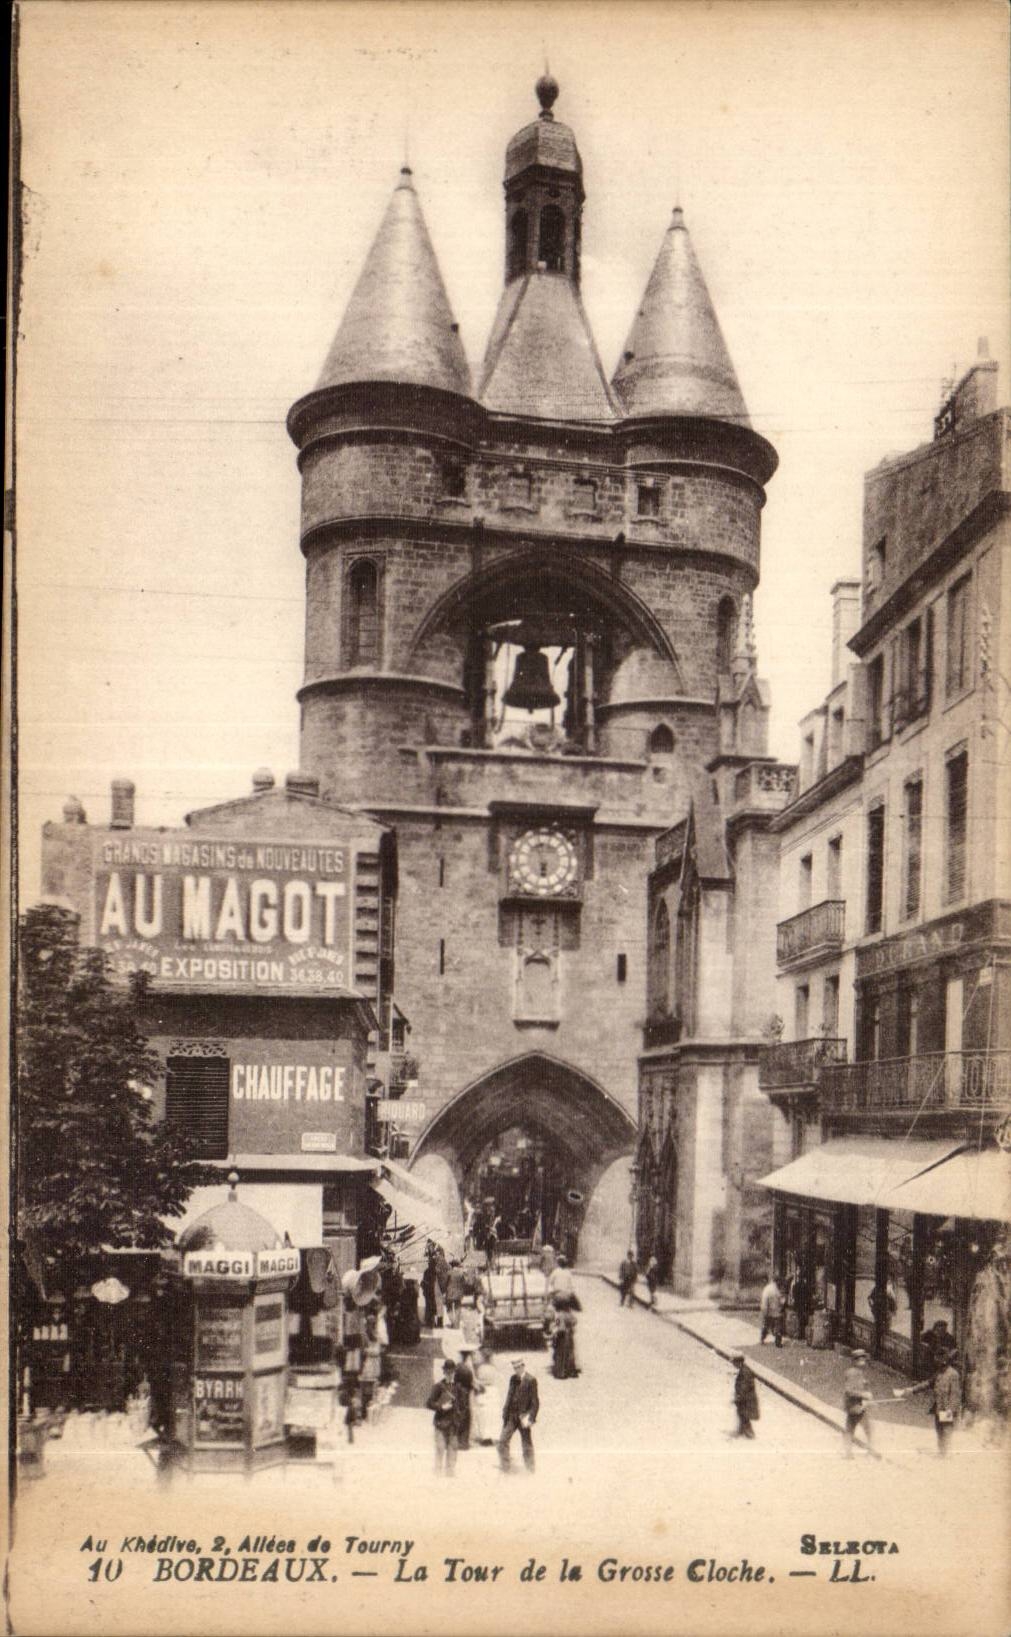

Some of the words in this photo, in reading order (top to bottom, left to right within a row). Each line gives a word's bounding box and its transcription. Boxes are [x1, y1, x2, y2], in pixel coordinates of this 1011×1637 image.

[162, 845, 236, 869] MAGASINS
[100, 872, 163, 938] AU
[182, 875, 346, 945] MAGOT
[161, 956, 285, 982] EXPOSITION
[232, 1064, 346, 1101] CHAUFFAGE
[188, 1258, 250, 1275] MAGGI
[259, 1256, 299, 1274] MAGGI
